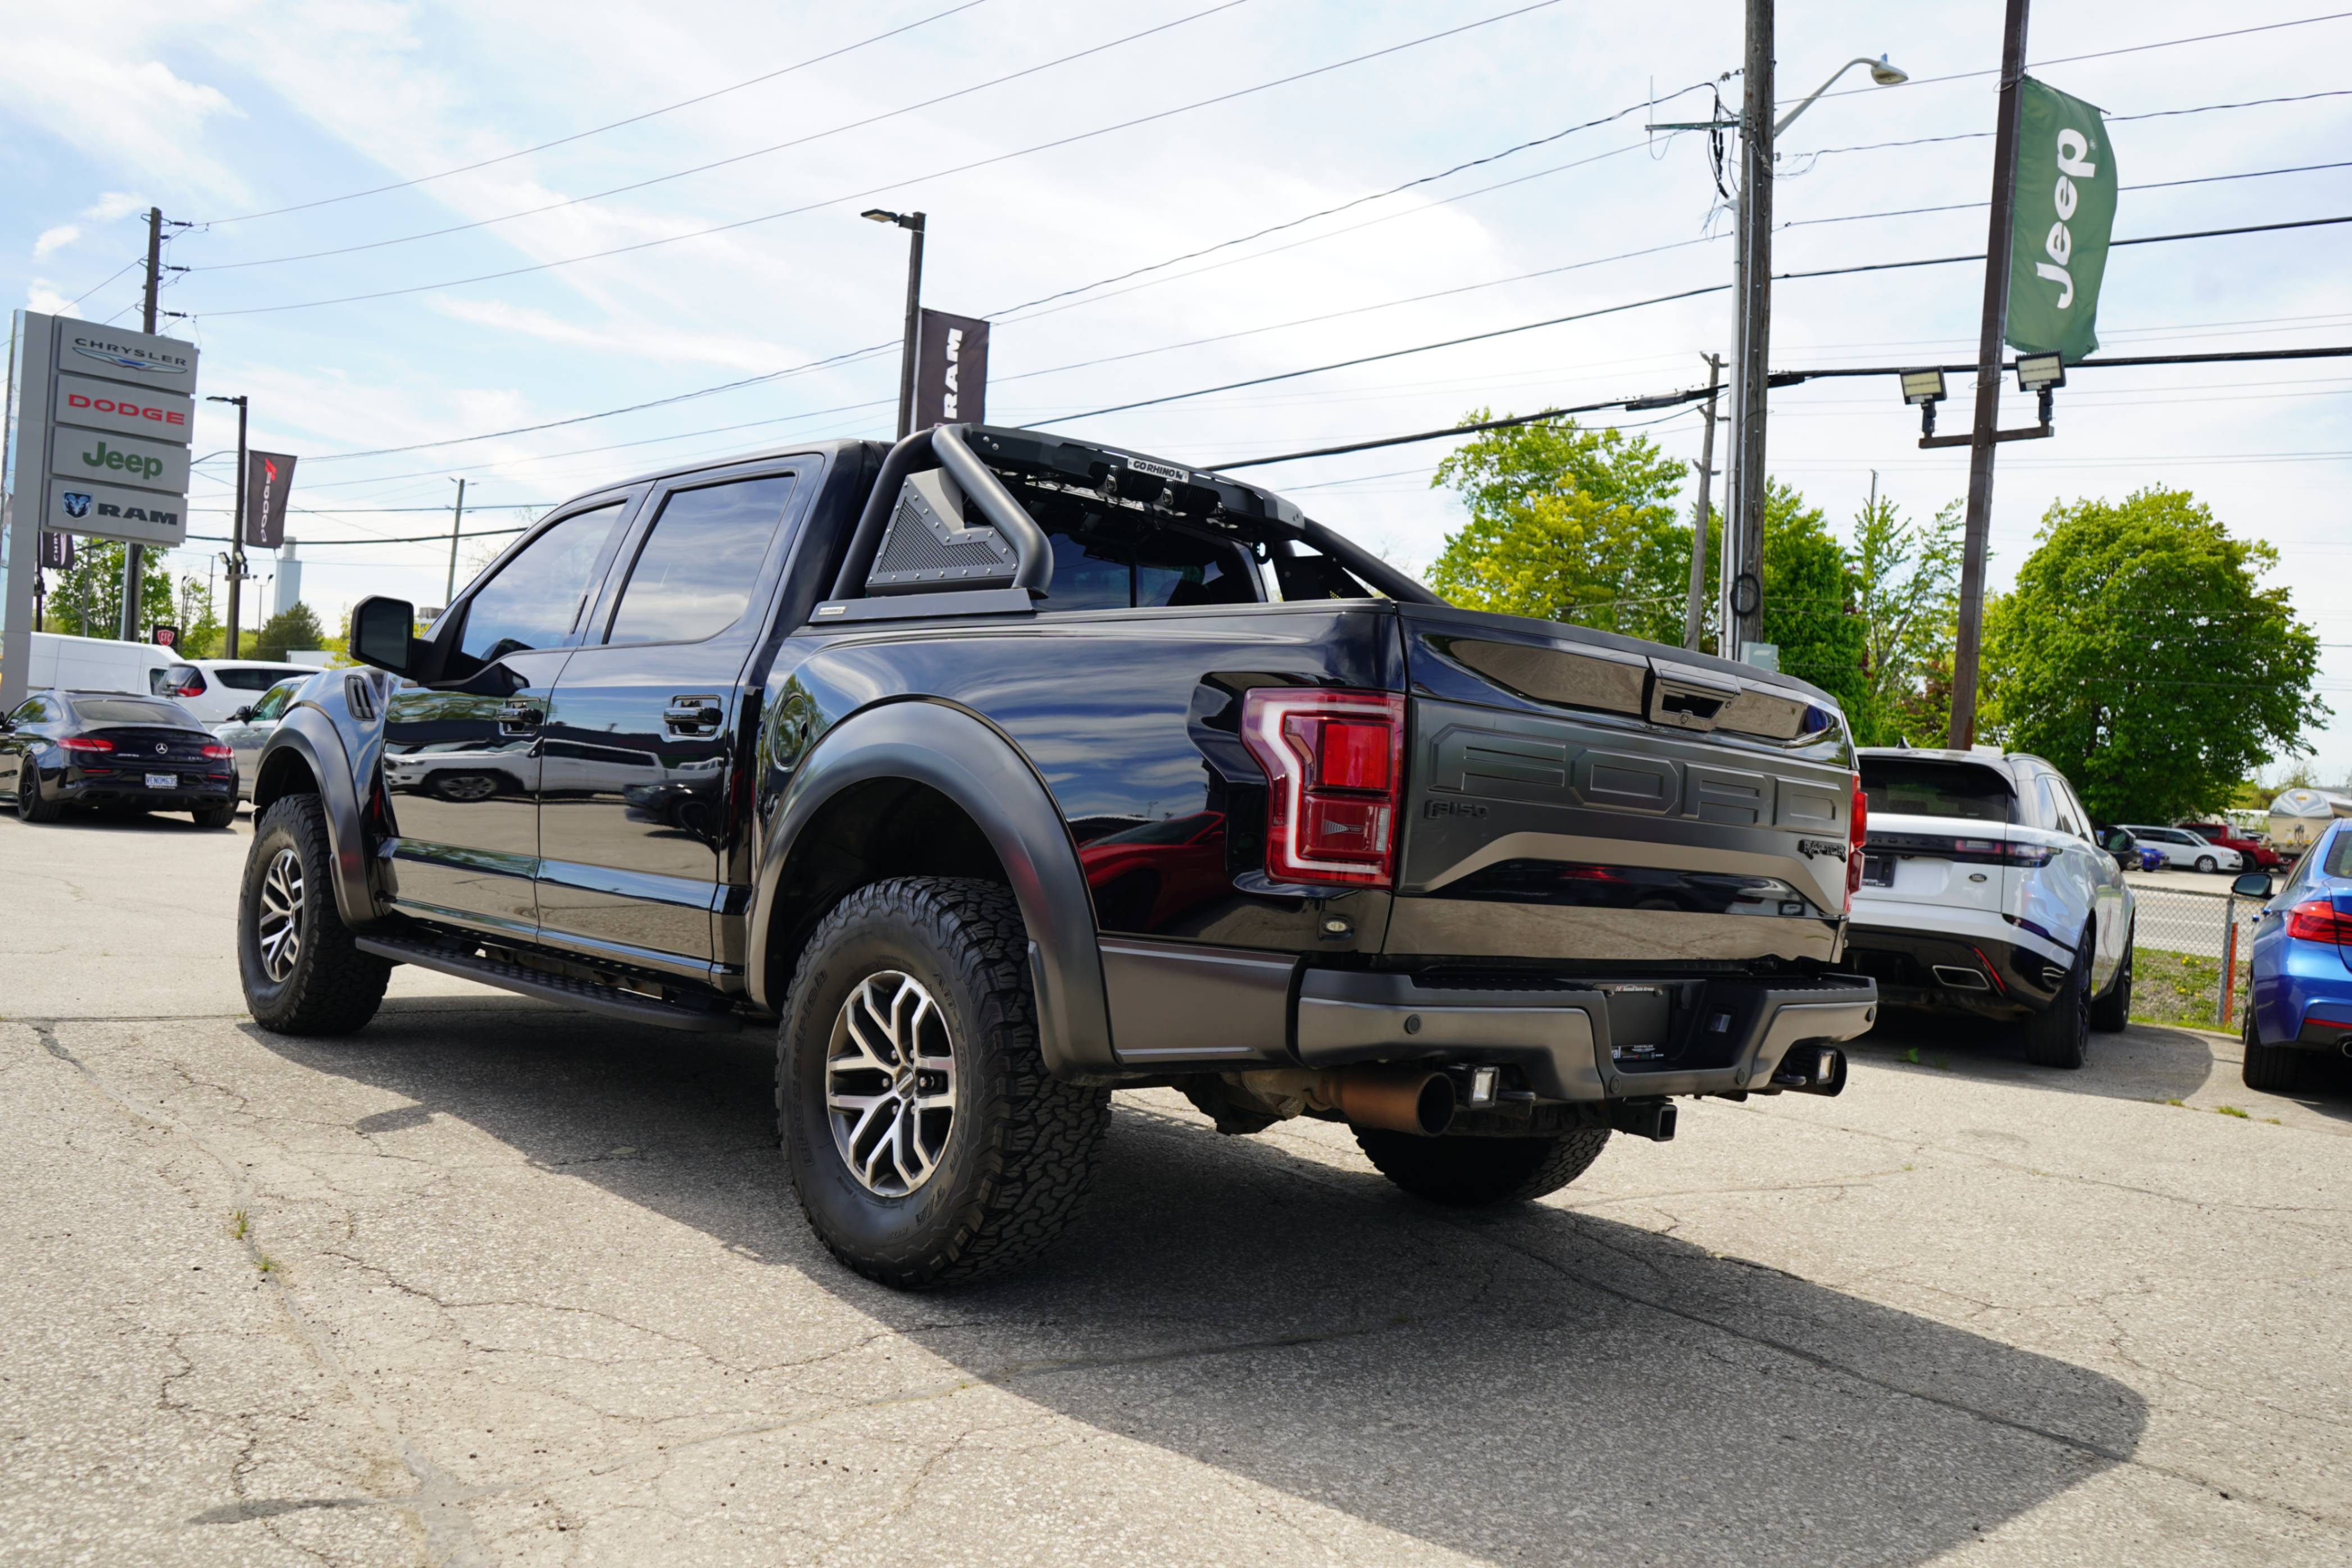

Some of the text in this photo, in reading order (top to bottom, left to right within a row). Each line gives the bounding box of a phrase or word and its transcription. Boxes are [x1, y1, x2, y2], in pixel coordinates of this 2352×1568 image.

[2036, 128, 2096, 309] Jeep
[74, 338, 187, 366] CHRYSLER
[943, 328, 963, 419] RAM
[68, 394, 185, 426] DODGE
[82, 441, 163, 480] Jeep
[97, 502, 178, 526] RAM
[260, 471, 272, 543] DODGE
[146, 776, 178, 785] VENOM63S
[1429, 723, 1848, 837] FORD
[1798, 839, 1846, 863] RAPTOR
